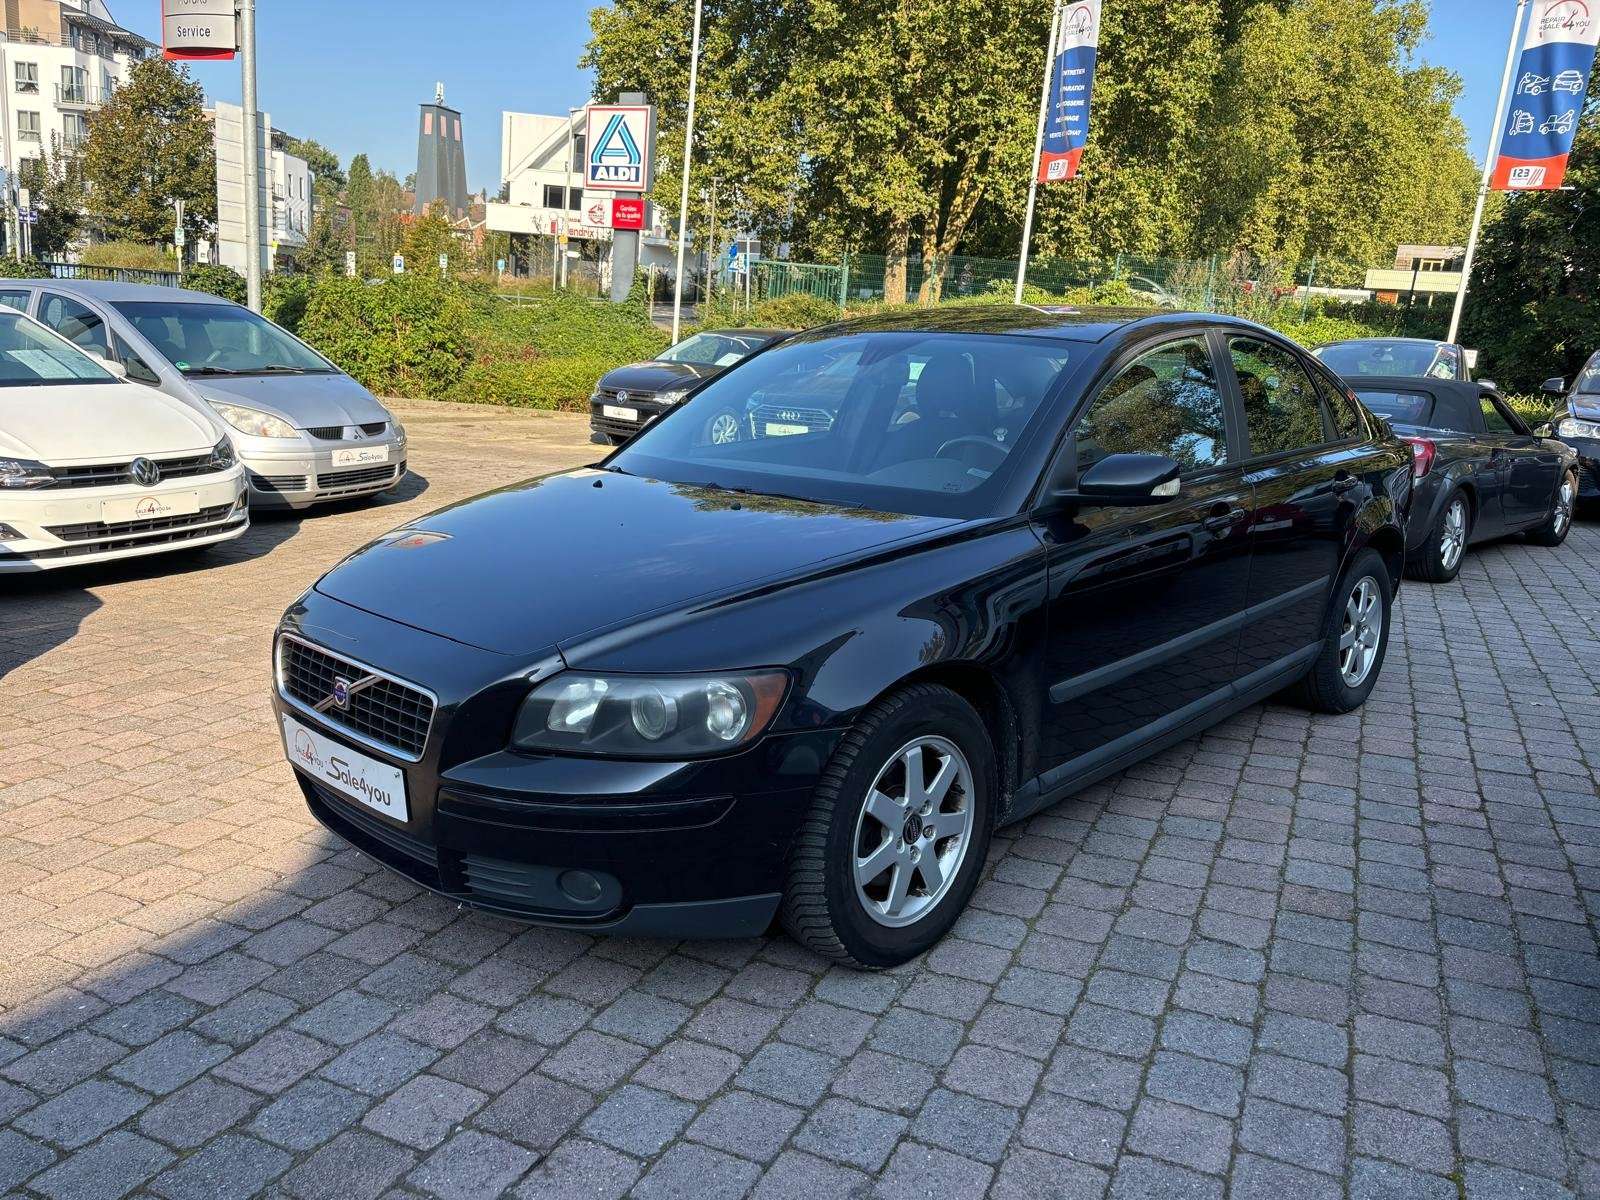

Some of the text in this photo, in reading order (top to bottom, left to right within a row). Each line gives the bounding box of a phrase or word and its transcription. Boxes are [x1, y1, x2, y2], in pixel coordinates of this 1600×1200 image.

[1541, 16, 1566, 24] REPAIR
[177, 25, 211, 37] Service
[1050, 162, 1060, 171] 123
[595, 167, 637, 181] ALDI
[1512, 168, 1530, 177] 123
[326, 756, 391, 806] Sale4you
